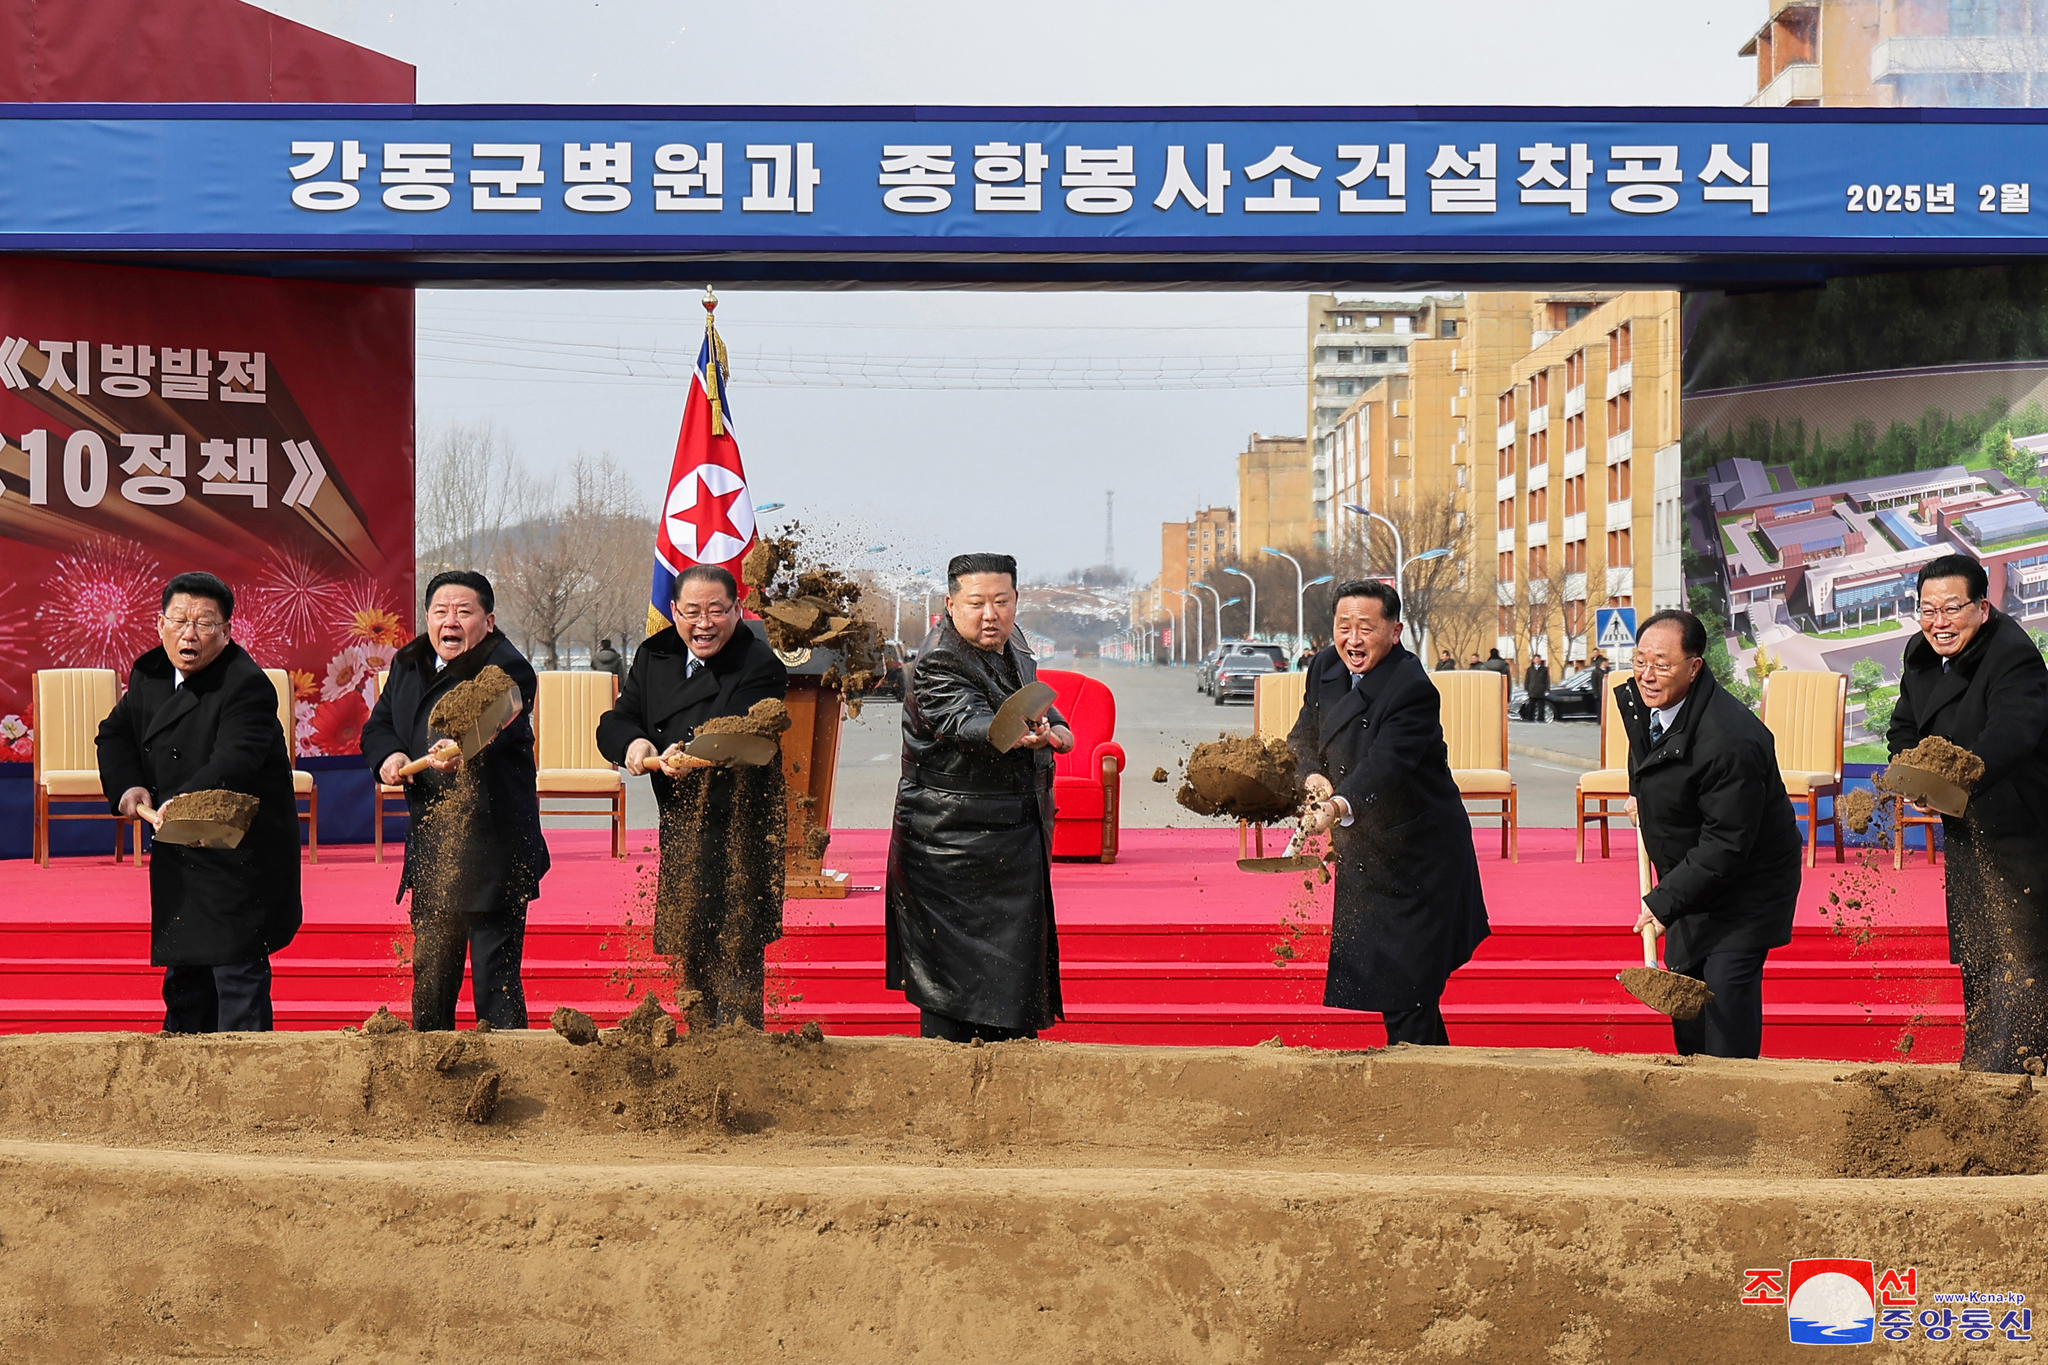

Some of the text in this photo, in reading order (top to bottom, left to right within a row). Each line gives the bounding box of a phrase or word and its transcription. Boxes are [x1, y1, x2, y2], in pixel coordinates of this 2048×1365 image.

[288, 139, 1772, 215] 강동군병원과 종합봉사소건설착공식
[1846, 182, 2030, 213] 2025년 2월
[0, 427, 328, 509] 10정책》
